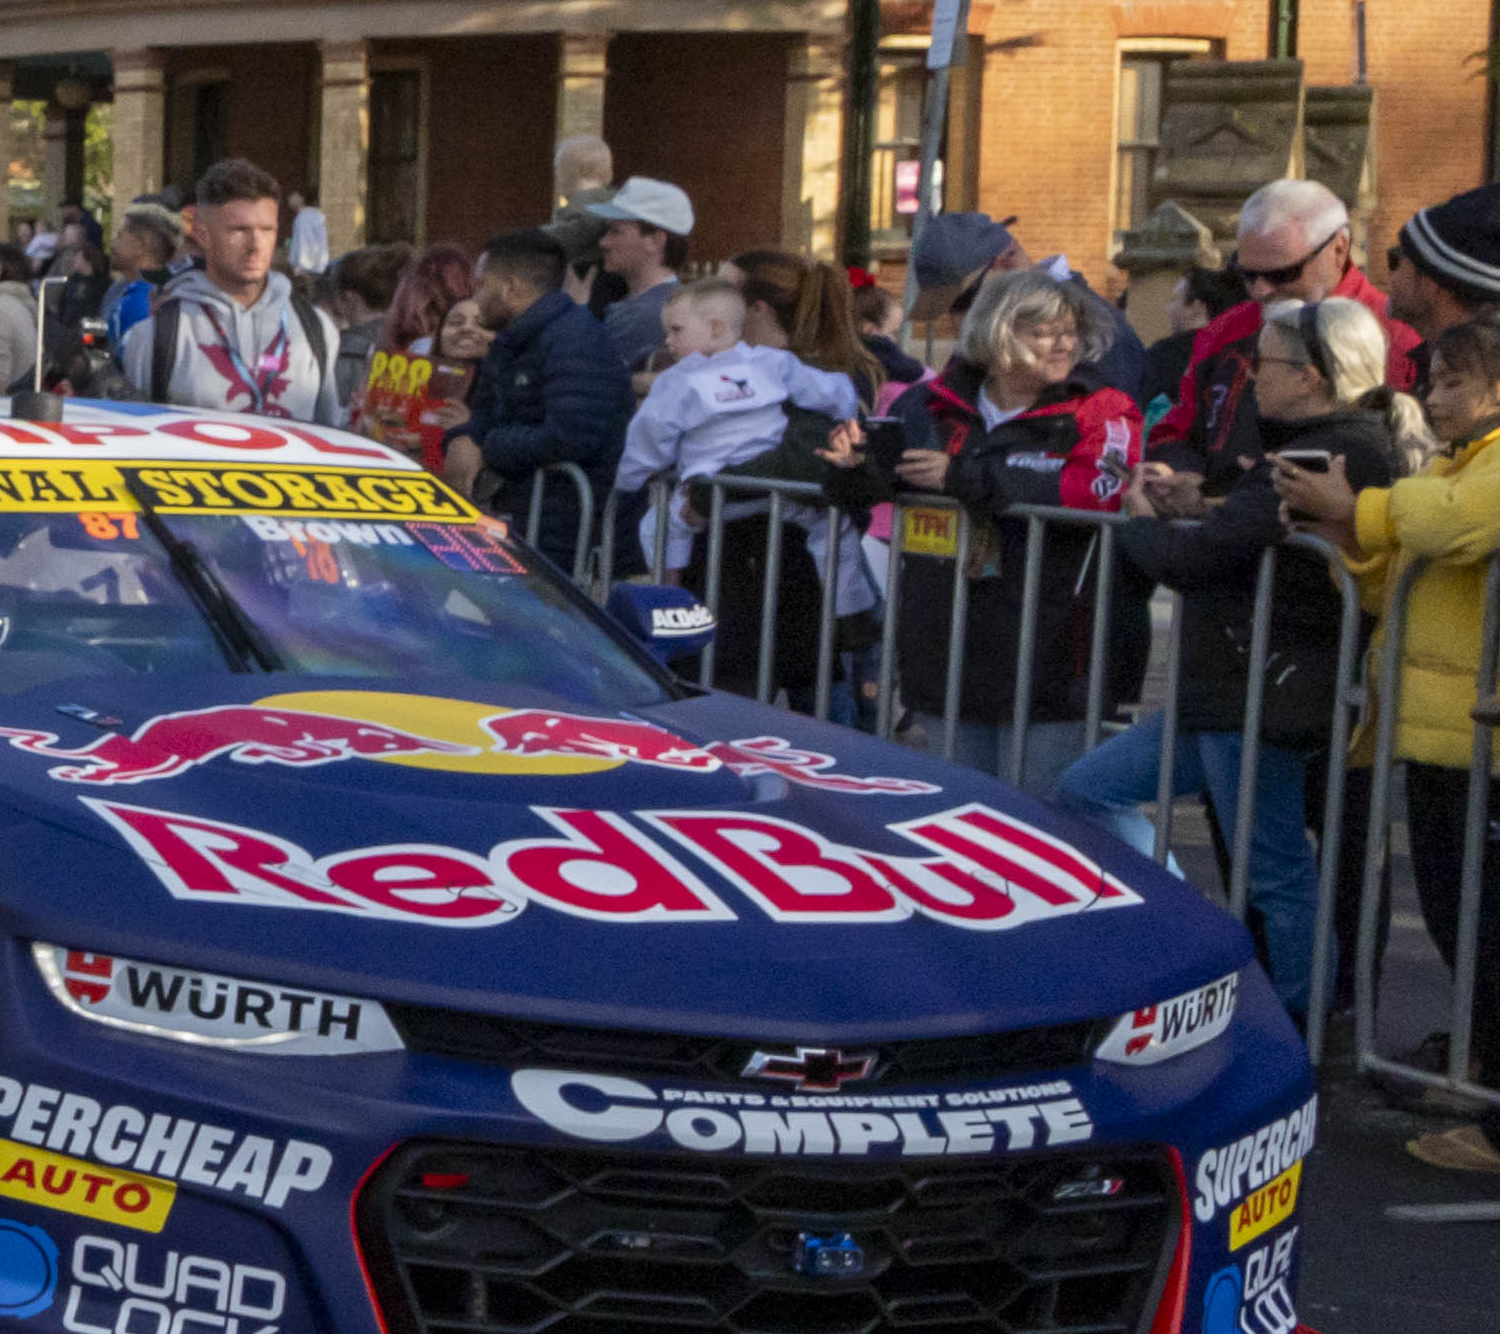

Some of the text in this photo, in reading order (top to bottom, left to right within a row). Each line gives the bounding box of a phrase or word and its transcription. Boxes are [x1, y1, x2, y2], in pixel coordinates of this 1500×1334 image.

[146, 467, 458, 515] STORAGE
[78, 510, 140, 541] 87
[241, 516, 414, 547] Brown
[90, 799, 1140, 928] Red Bull
[127, 966, 361, 1041] WÜRTH
[510, 1067, 1095, 1156] COMPLETE
[662, 1088, 767, 1107] PARTS
[946, 1079, 1073, 1107] SOLUTIONS
[0, 1157, 151, 1215] AUTO
[1195, 1092, 1318, 1223] SUPERCH
[1236, 1177, 1293, 1233] AUTO
[71, 1234, 287, 1322] QUAD
